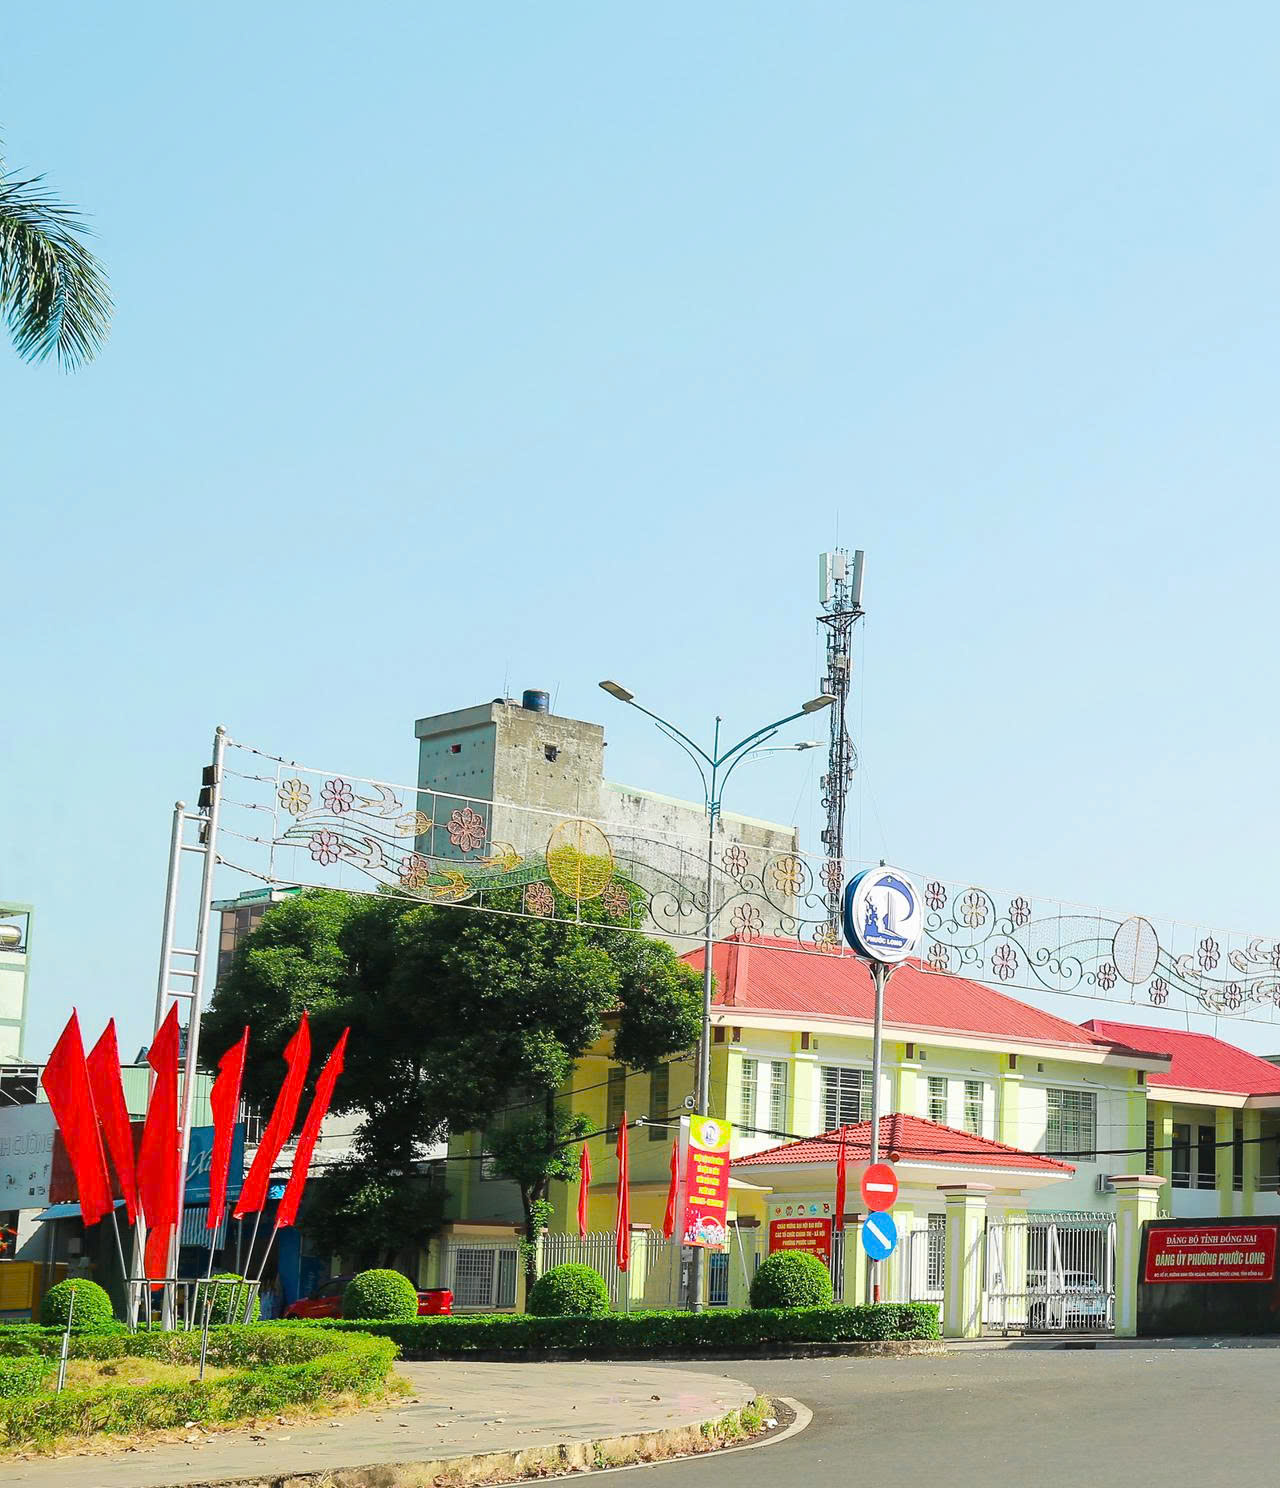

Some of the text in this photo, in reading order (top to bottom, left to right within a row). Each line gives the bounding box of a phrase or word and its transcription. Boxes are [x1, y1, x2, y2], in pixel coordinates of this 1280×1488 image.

[1166, 1232, 1257, 1246] ĐẢNG BỘ TỈNH ĐỒNG NAI
[1155, 1249, 1266, 1267] ĐẢNG ỦY PHƯỜNG PHƯỚC LONG
